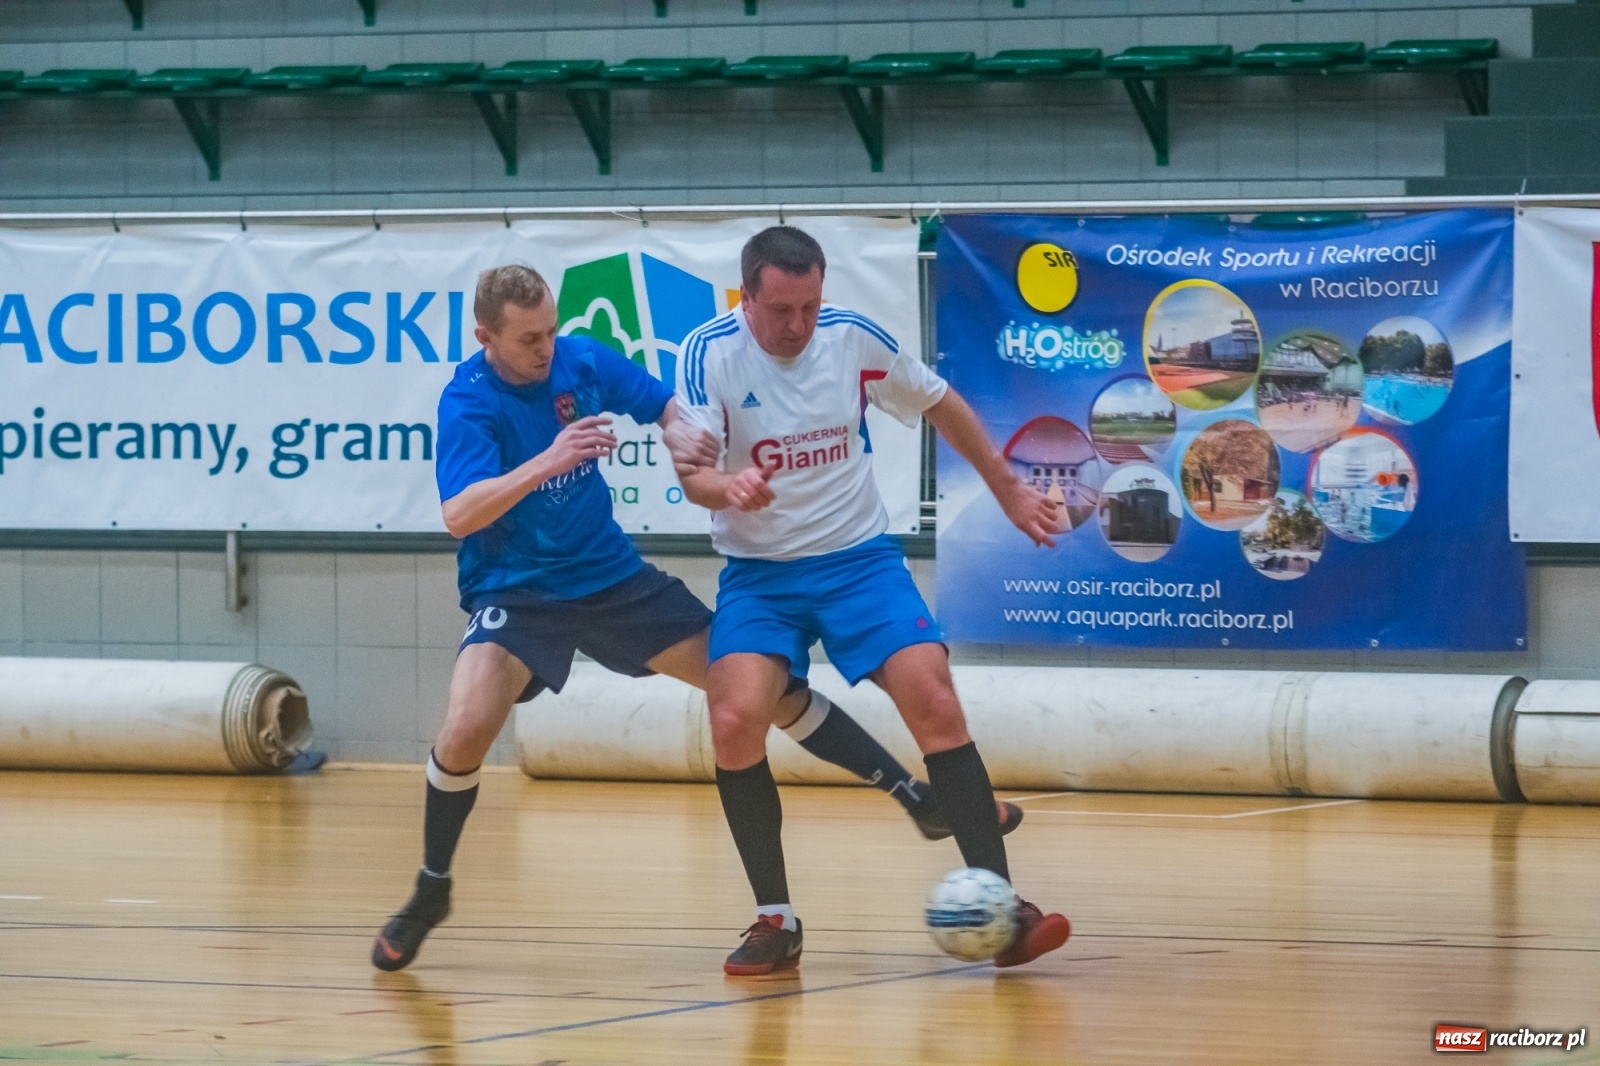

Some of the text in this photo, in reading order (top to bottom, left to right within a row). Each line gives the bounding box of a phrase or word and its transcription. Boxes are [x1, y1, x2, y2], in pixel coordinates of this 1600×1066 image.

[1107, 240, 1437, 271] Ośrodek Sportu i Rekreacji
[1279, 276, 1439, 299] w Raciborzu
[0, 290, 464, 365] ACIBORSKI
[783, 425, 849, 446] CUKIERNIA
[751, 437, 849, 471] Gianni
[1003, 577, 1221, 603] www.osir-raciborz.pl
[1003, 607, 1294, 633] www.aquapark.raciborz.pl
